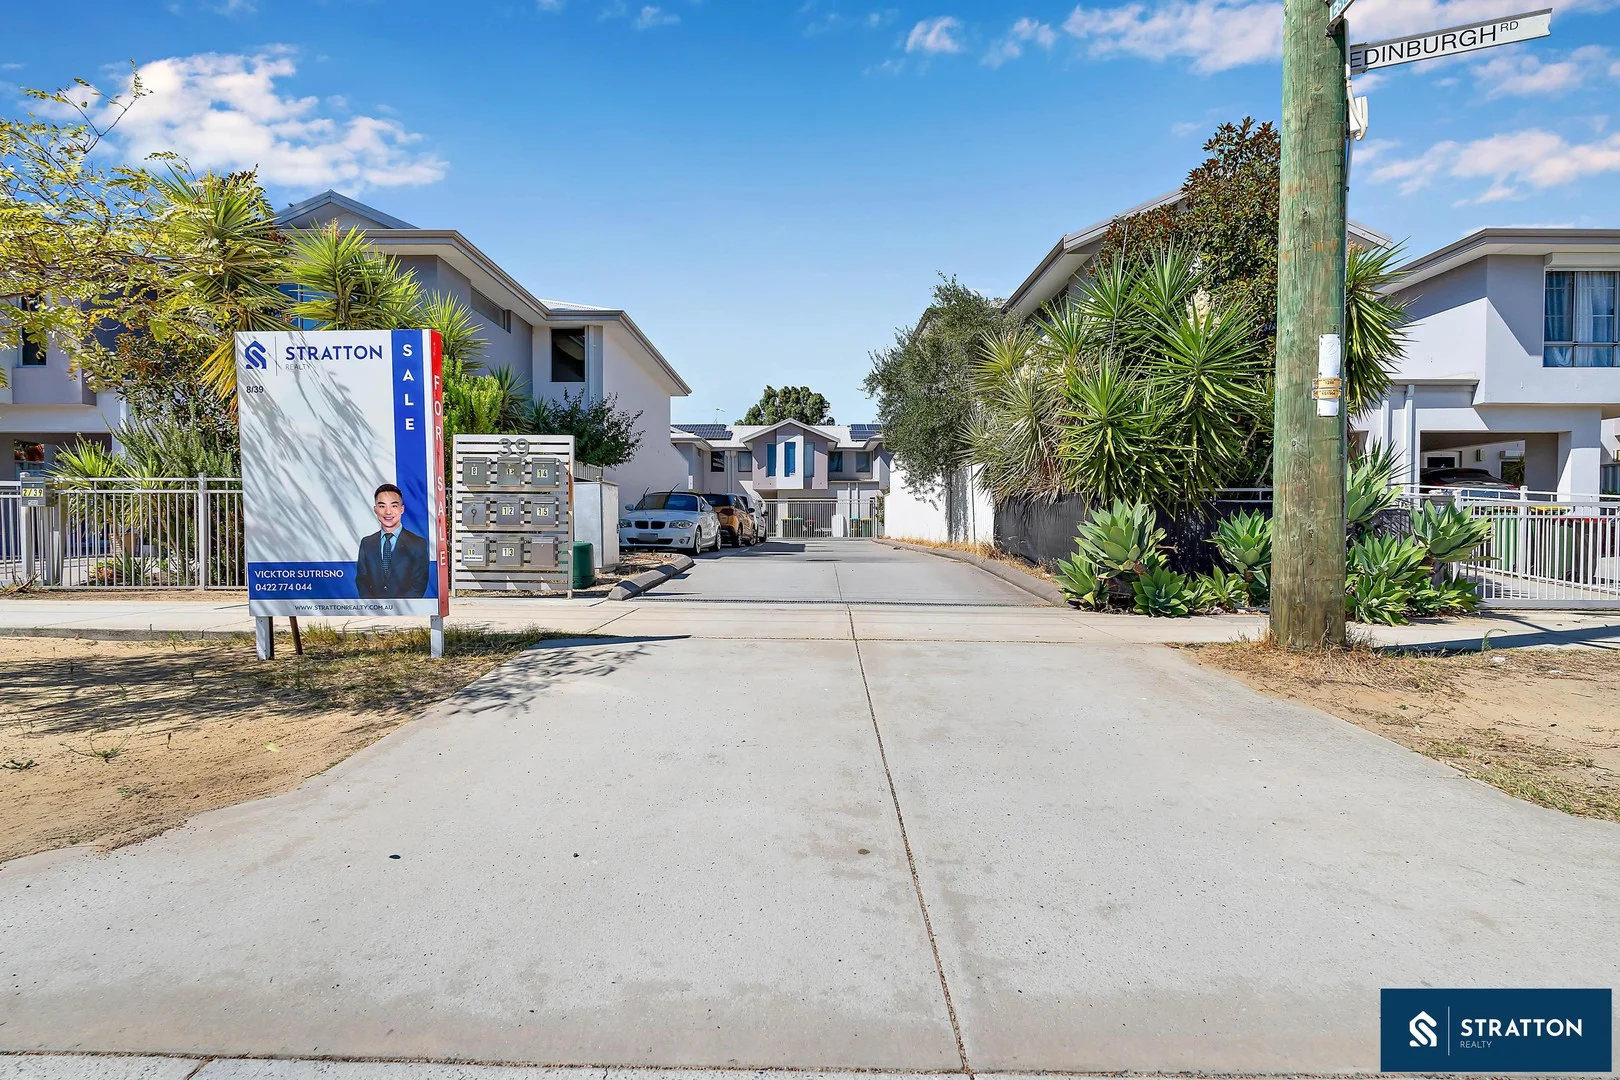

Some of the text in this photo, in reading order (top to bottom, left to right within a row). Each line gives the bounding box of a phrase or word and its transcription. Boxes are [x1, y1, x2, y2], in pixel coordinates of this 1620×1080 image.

[1350, 20, 1519, 68] EDINBURGH RD
[285, 345, 383, 361] STRATTON
[285, 363, 312, 371] REALTY
[246, 385, 264, 394] 8/39
[402, 344, 415, 431] SALE
[498, 438, 530, 457] 39
[433, 375, 446, 566] FOR SALE
[537, 469, 547, 478] 14
[23, 488, 43, 497] 2/39
[503, 507, 513, 515] 12
[538, 508, 548, 516] 15
[503, 548, 513, 556] 13
[254, 569, 344, 578] VICKTOR SUTRISNO
[255, 583, 312, 591] 0422 774 044
